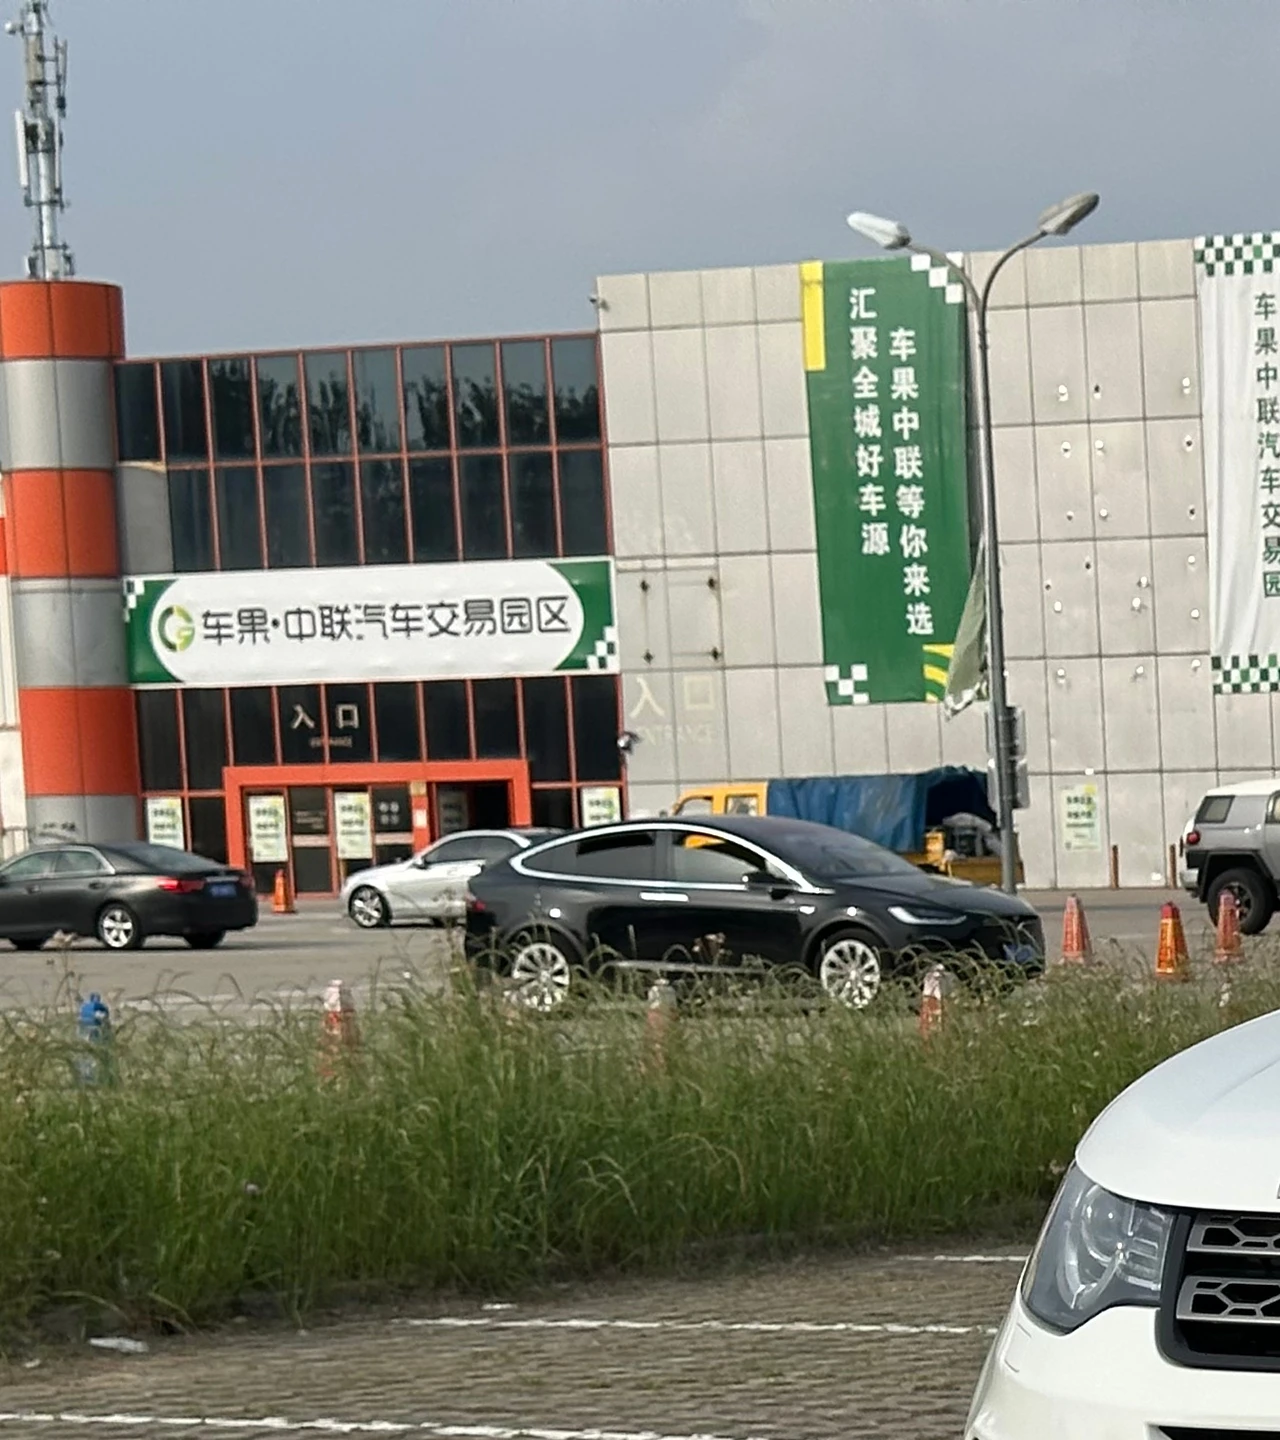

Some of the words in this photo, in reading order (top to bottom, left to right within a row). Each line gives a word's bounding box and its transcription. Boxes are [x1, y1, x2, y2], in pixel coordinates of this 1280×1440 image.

[849, 288, 889, 555] 汇聚全城好车源
[889, 327, 934, 635] 车果中联等你来选
[202, 596, 571, 645] 车果·中联汽车交易园区
[290, 703, 359, 730] 入口
